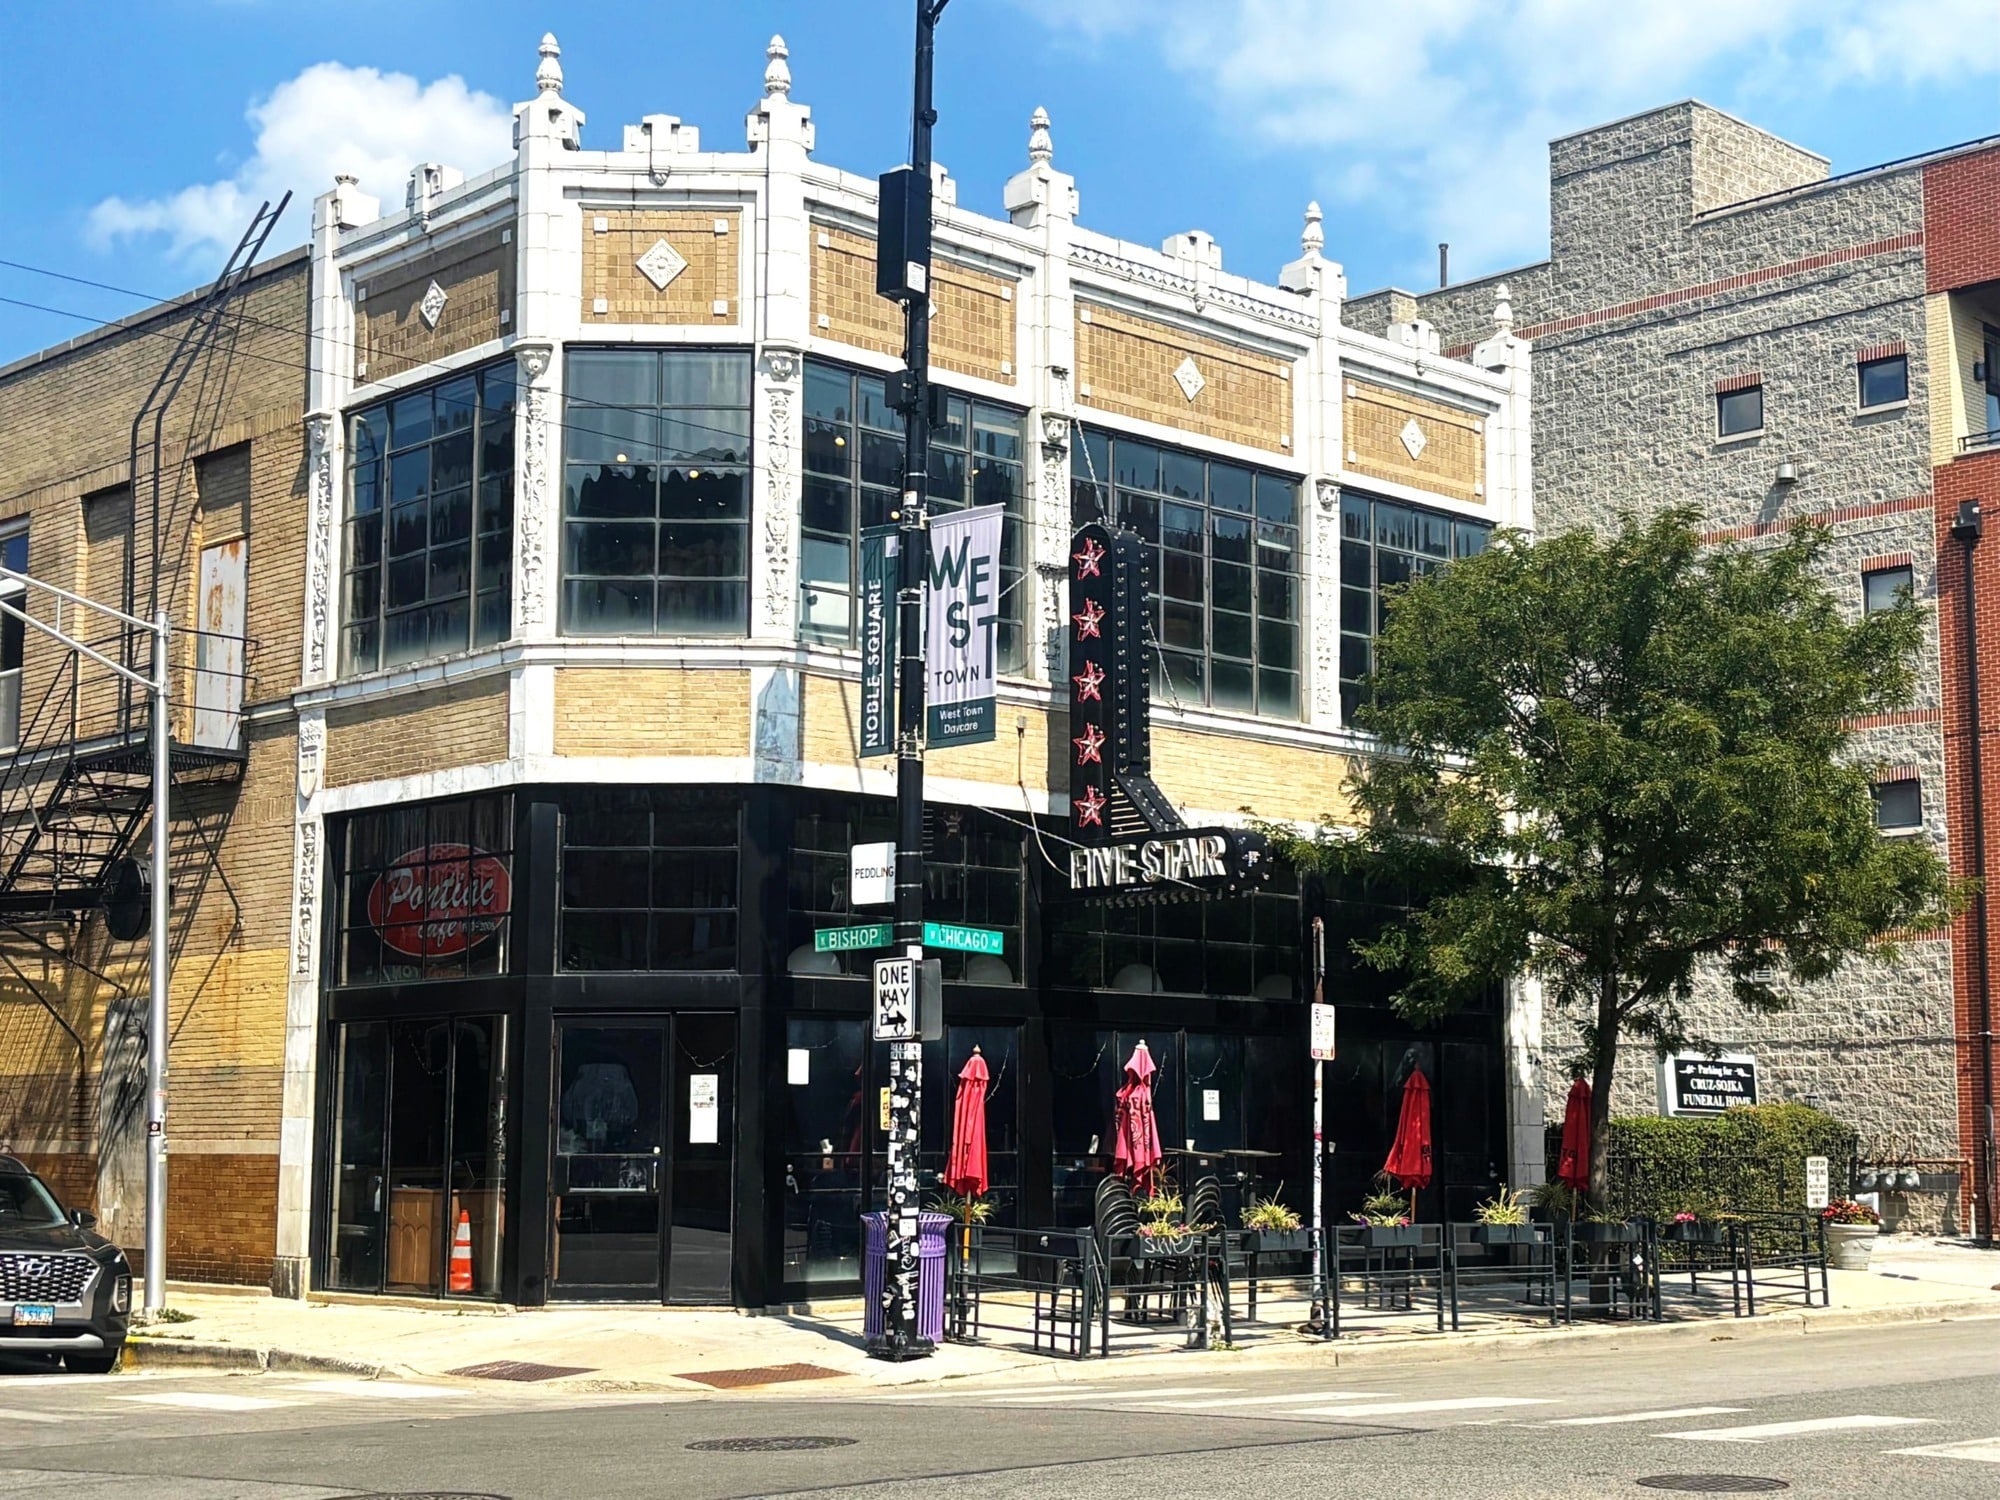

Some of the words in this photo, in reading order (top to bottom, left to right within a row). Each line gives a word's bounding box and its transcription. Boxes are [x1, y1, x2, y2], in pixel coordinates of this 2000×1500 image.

[867, 578, 882, 666] SQUARE
[934, 664, 980, 687] TOWN
[866, 675, 882, 747] NOBLE
[939, 708, 961, 720] West
[962, 706, 984, 717] Town
[943, 721, 978, 734] Daycare
[855, 865, 894, 879] PEDDLING
[1070, 843, 1137, 889] FIVE
[1141, 835, 1227, 883] STAR
[386, 867, 496, 918] Pontiac
[828, 928, 879, 948] BISHOP
[939, 927, 989, 950] CHICAGO
[880, 965, 909, 985] ONE
[880, 987, 910, 1007] WAY
[1697, 1064, 1722, 1077] Parking
[1690, 1078, 1744, 1092] CRUZ-SOJKA
[1682, 1093, 1725, 1107] FUNERAL
